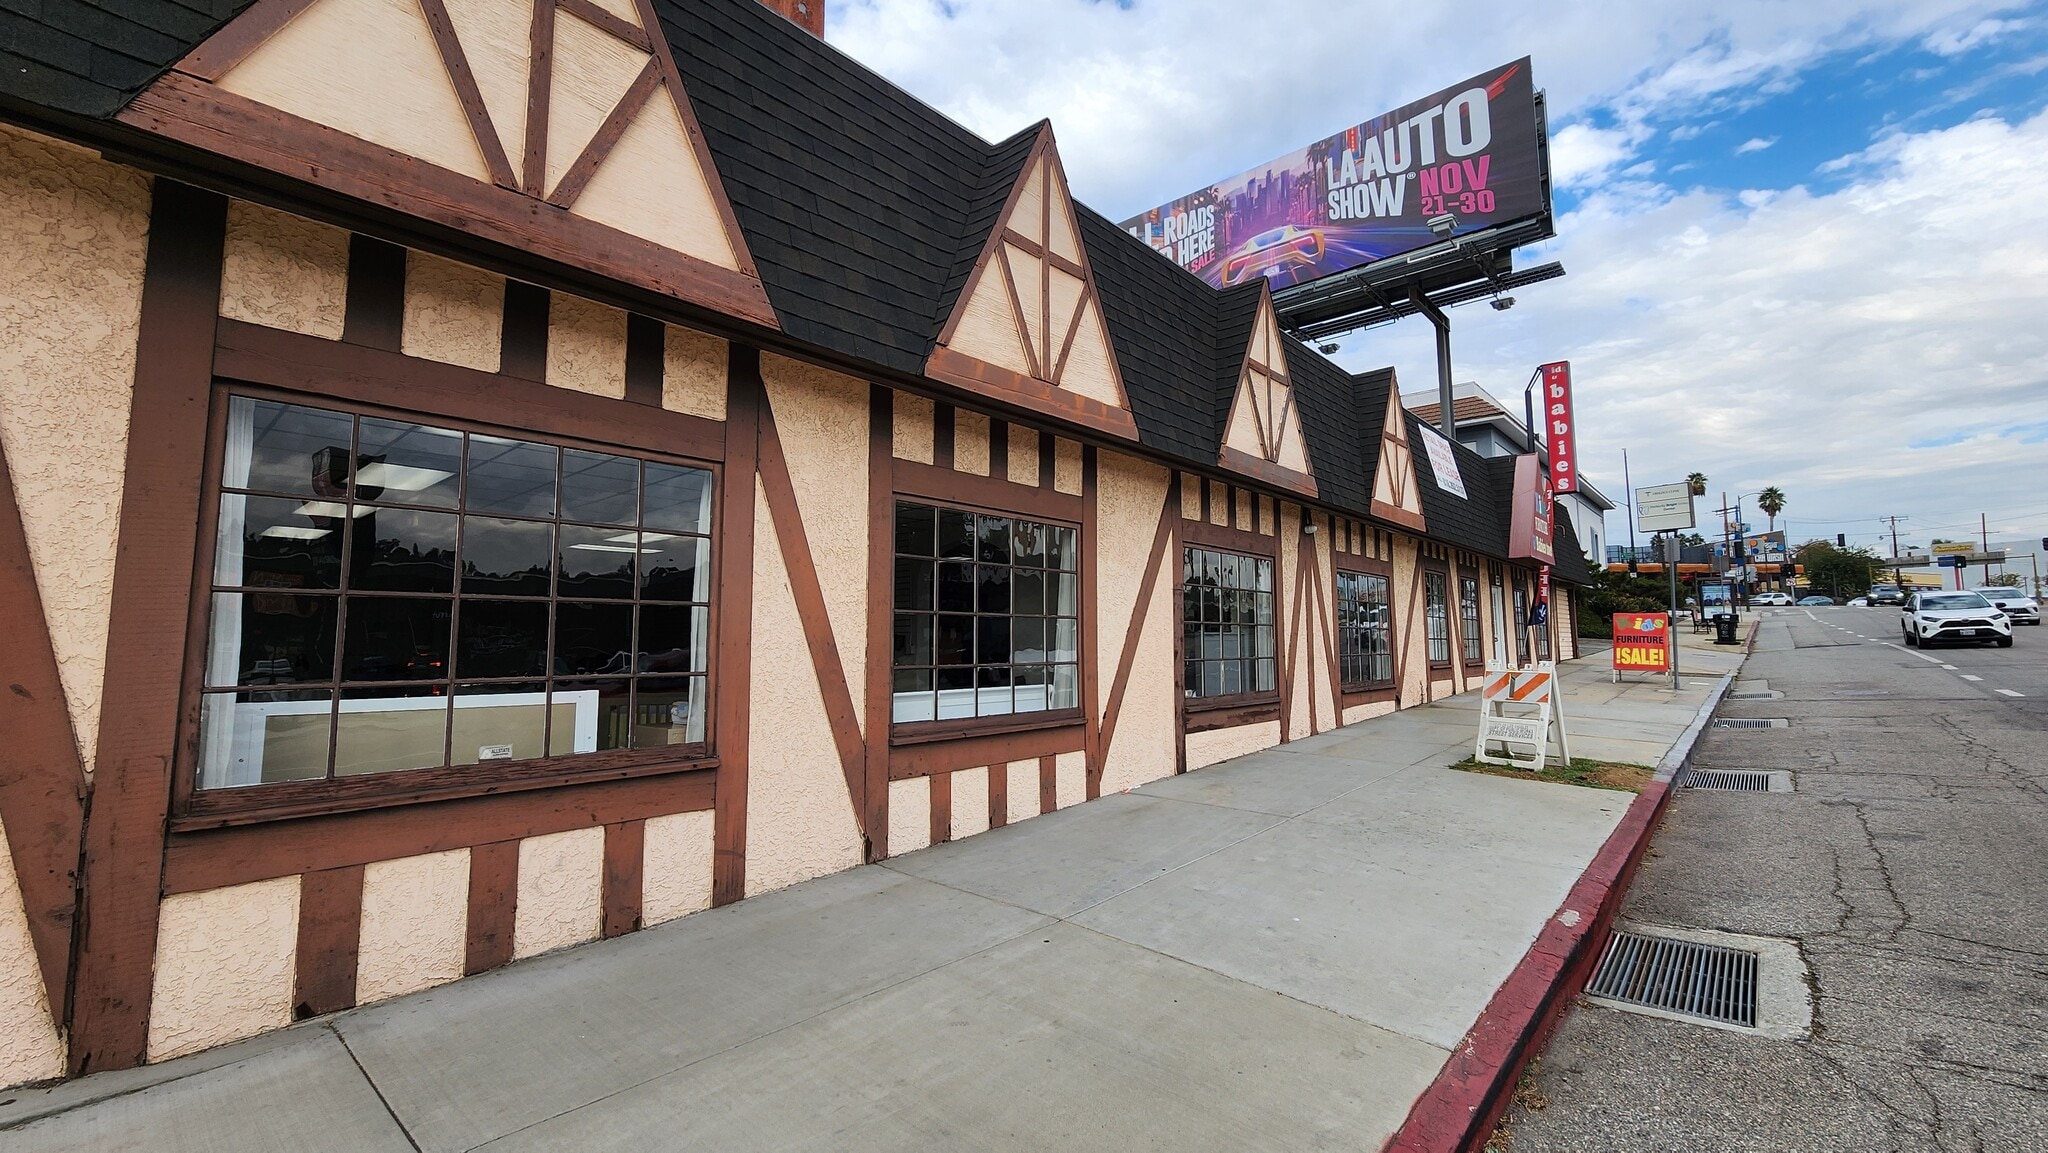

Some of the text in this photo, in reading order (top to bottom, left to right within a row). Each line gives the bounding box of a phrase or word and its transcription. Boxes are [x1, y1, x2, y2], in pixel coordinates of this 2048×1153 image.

[1327, 87, 1491, 190] LA AUTO
[1419, 154, 1490, 197] NOV
[1327, 174, 1406, 220] SHOW
[1421, 190, 1496, 216] 21-30
[1163, 204, 1215, 247] ROADS
[1177, 226, 1216, 268] HERE
[1191, 248, 1216, 274] SALE
[1549, 383, 1570, 490] babies
[1431, 459, 1461, 482] FOR LEASE
[1616, 635, 1664, 645] FURNITURE
[1616, 647, 1665, 666] !SALE!
